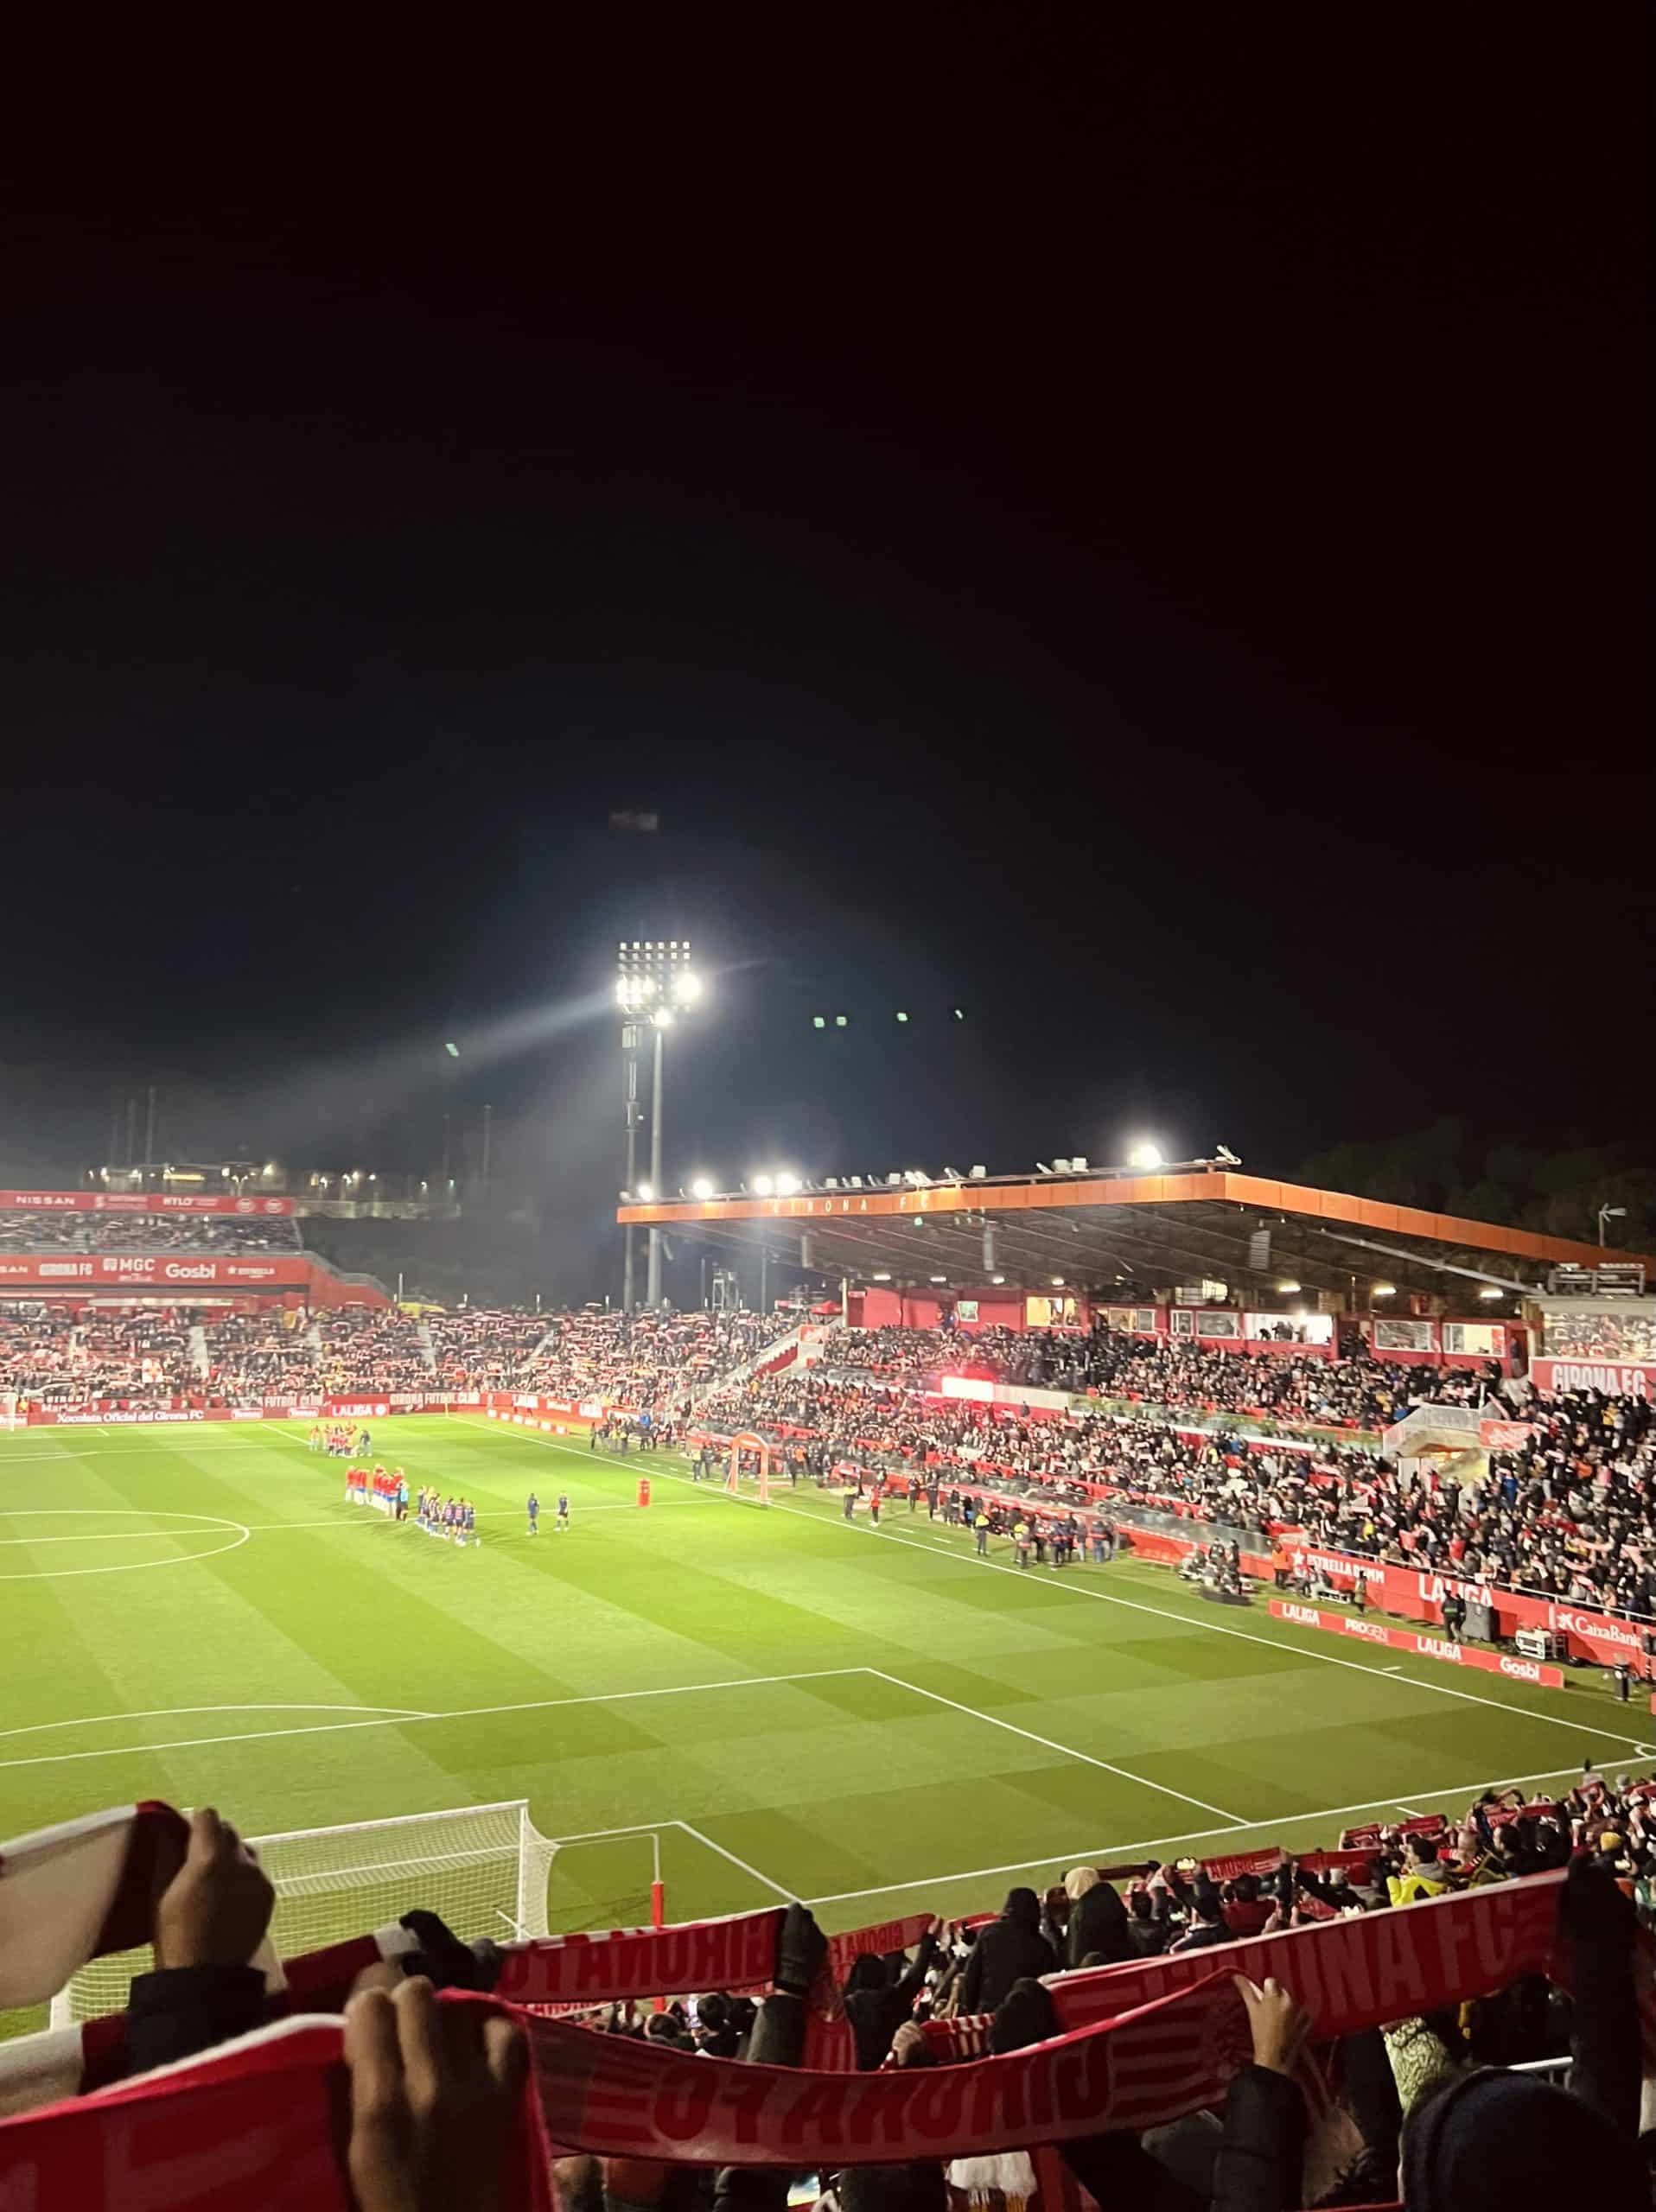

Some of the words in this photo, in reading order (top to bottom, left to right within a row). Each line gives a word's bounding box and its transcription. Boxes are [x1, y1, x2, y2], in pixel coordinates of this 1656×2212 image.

[16, 1195, 76, 1205] NISSAN
[119, 1258, 156, 1272] MGC
[165, 1263, 216, 1279] Gosbi
[190, 1409, 205, 1420] FC
[332, 1405, 373, 1416] LALIGA
[1283, 1602, 1321, 1625] LALIGA
[1575, 1617, 1642, 1648] CaixaBank
[1417, 1636, 1462, 1660] LALIGA
[1500, 1656, 1539, 1680] Gosbi
